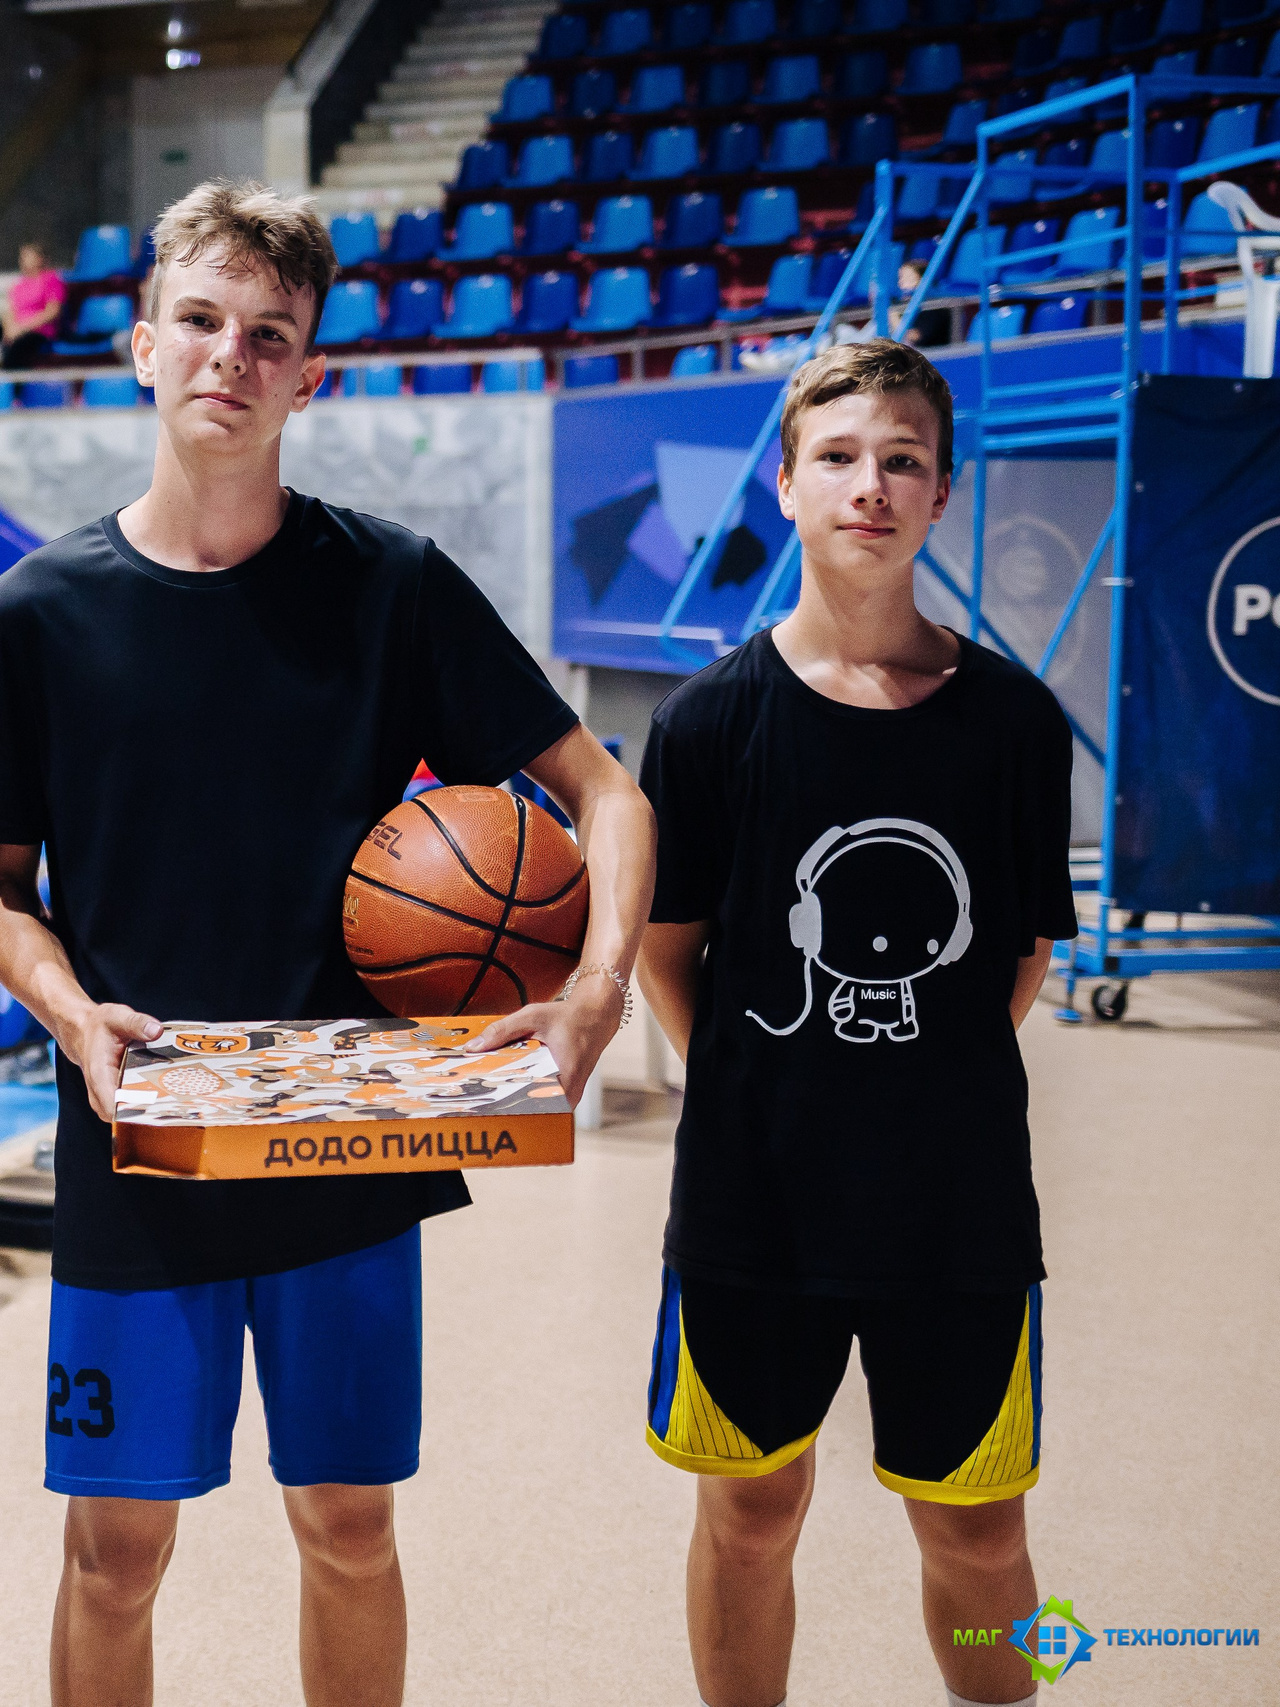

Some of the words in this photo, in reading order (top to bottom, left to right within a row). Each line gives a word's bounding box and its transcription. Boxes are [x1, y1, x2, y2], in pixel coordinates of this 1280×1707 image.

[860, 988, 897, 1000] Music
[264, 1134, 372, 1168] ДОДО
[381, 1130, 518, 1161] ПИЦЦА
[48, 1362, 116, 1439] 23
